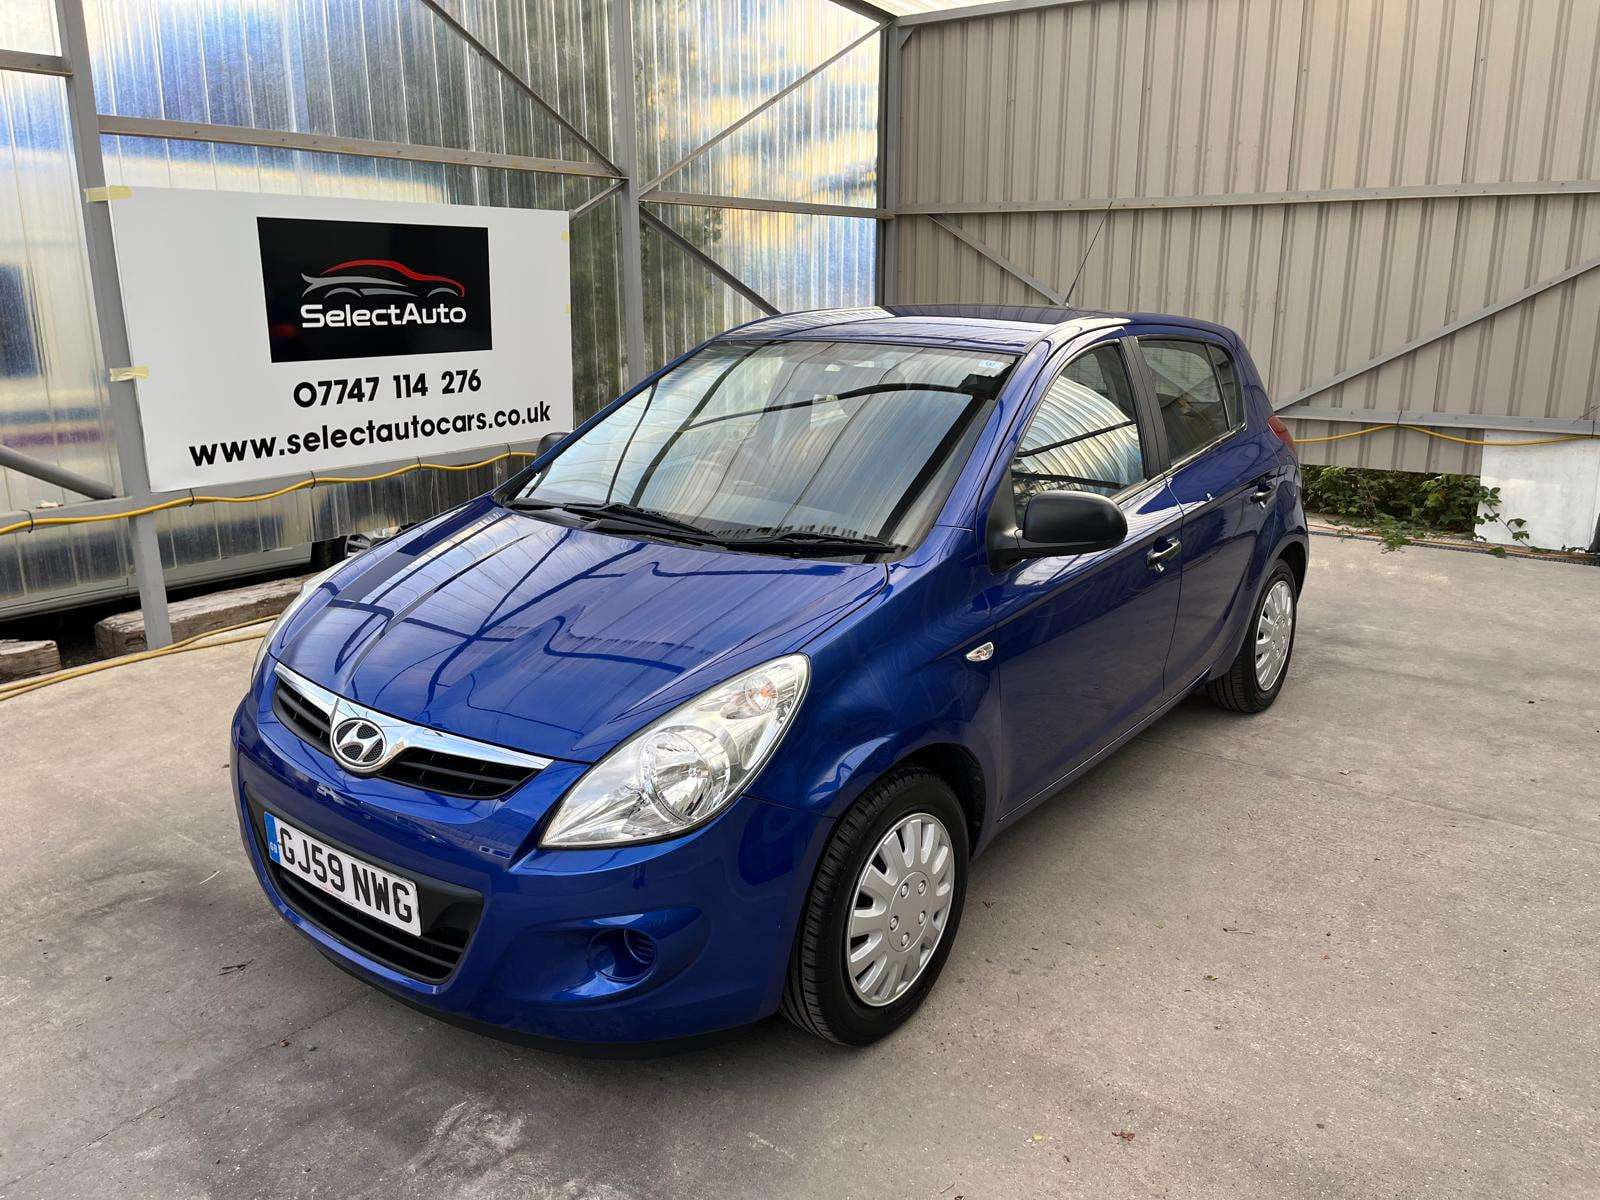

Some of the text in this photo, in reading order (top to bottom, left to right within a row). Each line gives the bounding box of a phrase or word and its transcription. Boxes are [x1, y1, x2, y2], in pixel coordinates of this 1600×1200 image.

[300, 302, 467, 328] SelectAuto
[293, 368, 482, 408] 07747 114 276
[189, 401, 551, 467] www.selectautocars.co.uk
[279, 827, 412, 924] GJ59 NWG
